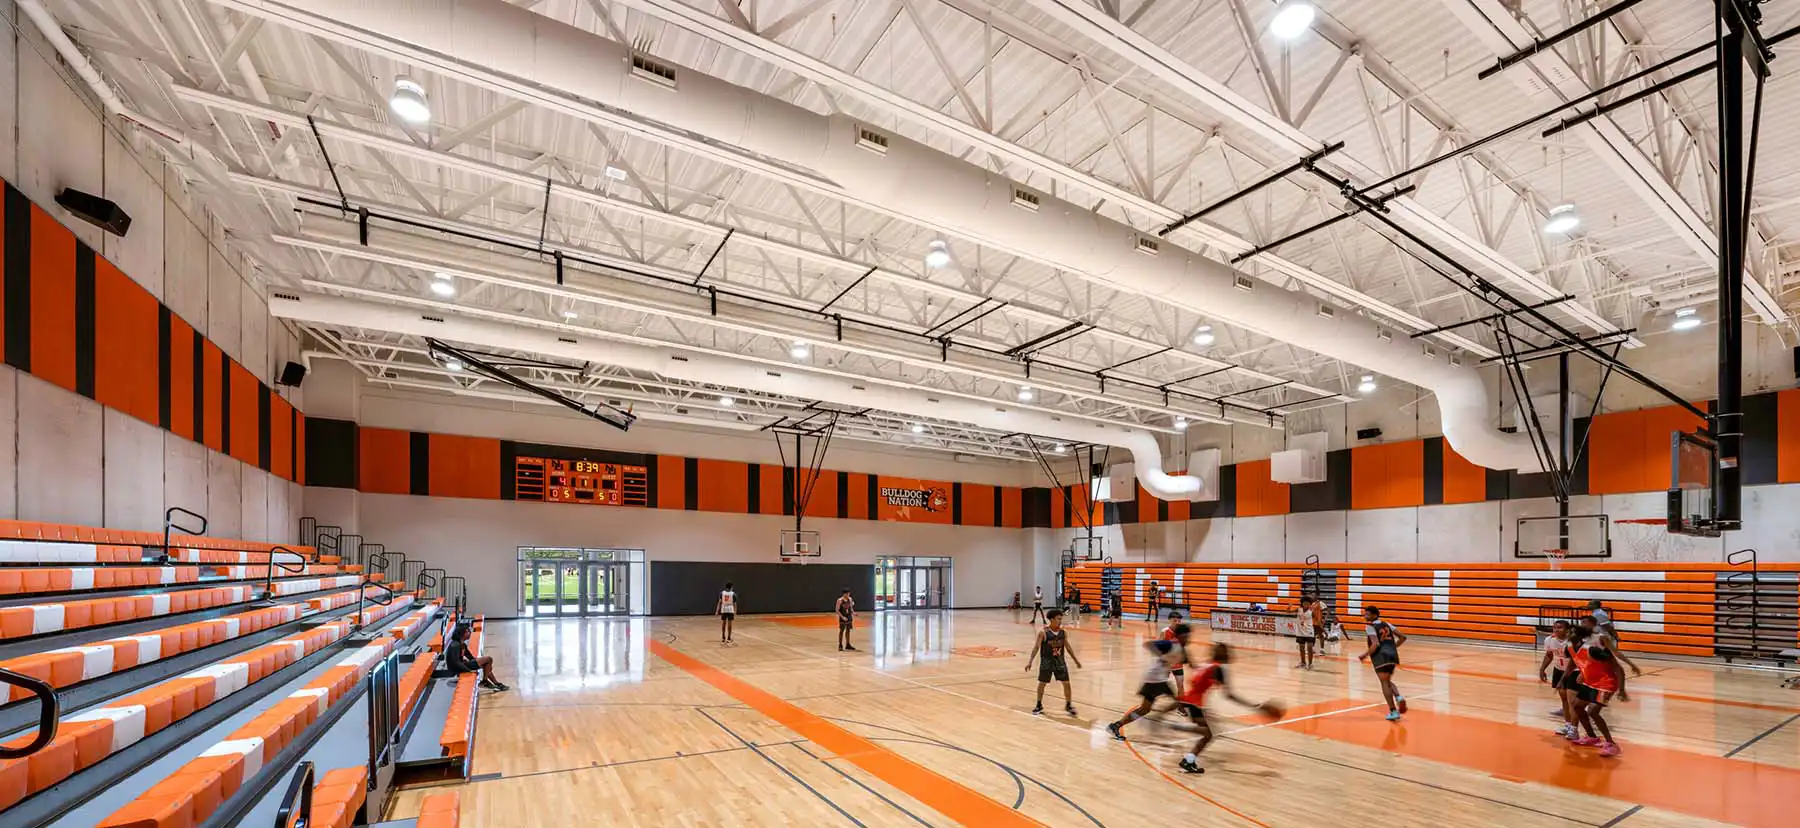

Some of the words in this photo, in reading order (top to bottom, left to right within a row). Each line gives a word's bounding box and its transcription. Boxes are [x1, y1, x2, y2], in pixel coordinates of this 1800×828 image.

[576, 461, 599, 473] 8:39
[559, 477, 567, 486] 4
[552, 489, 558, 498] 0
[563, 490, 570, 498] 5
[598, 492, 605, 500] 5
[611, 493, 617, 501] 0
[881, 488, 922, 499] BULLDOG
[888, 496, 923, 507] NATION
[1231, 621, 1276, 632] BULLDOGS
[1379, 626, 1393, 642] 22
